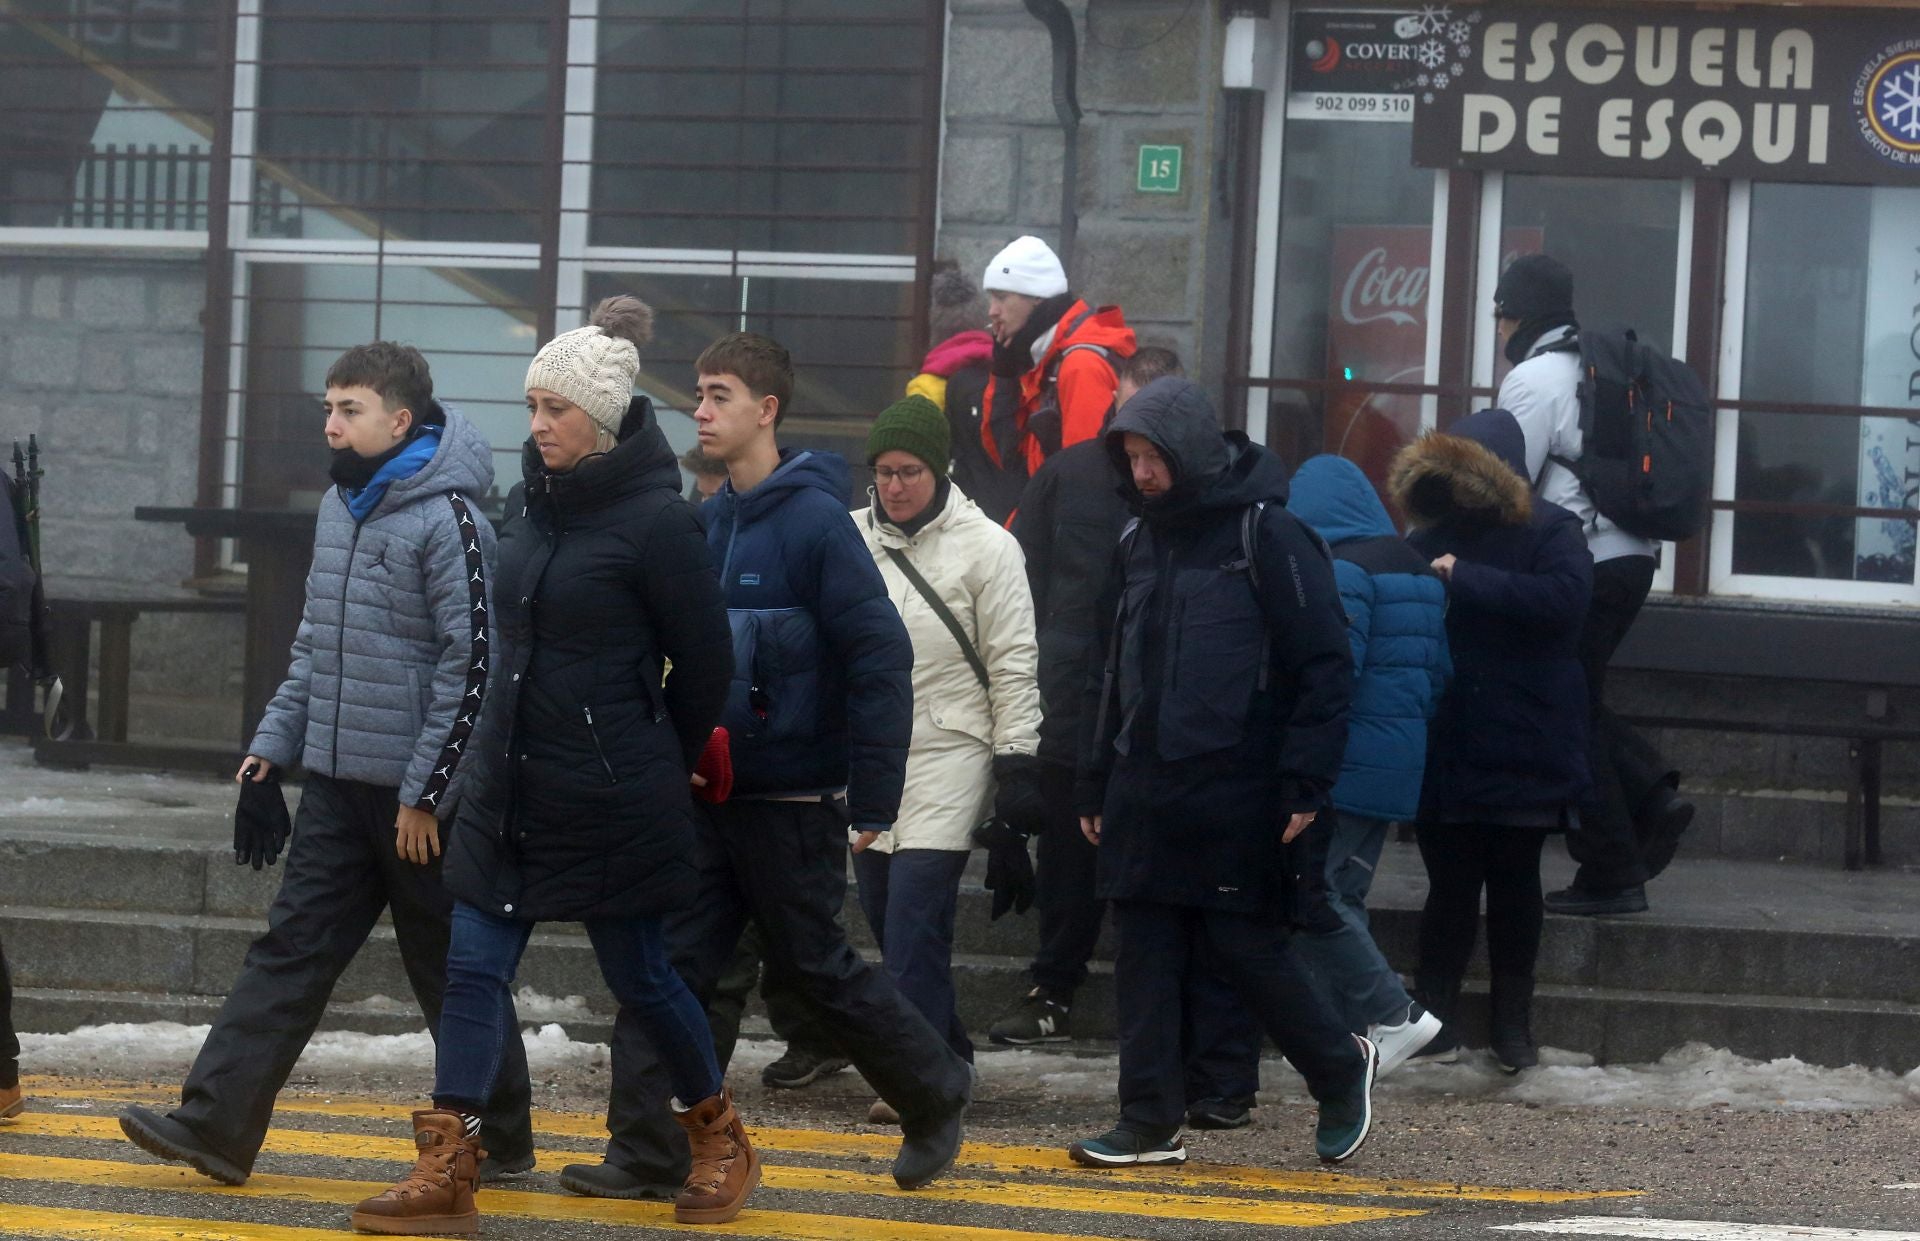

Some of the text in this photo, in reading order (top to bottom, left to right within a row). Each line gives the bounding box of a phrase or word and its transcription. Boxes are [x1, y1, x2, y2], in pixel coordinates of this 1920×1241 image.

[1482, 21, 1815, 90] ESCUELA
[1852, 53, 1886, 106] ESCUELA
[1315, 97, 1410, 113] 902 099 510
[1460, 93, 1830, 166] DE ESQUI
[1858, 117, 1891, 157] PUERTO
[1890, 150, 1906, 164] DE
[1150, 159, 1171, 178] 15
[1287, 553, 1308, 608] SALOMON
[1038, 1015, 1056, 1036] N
